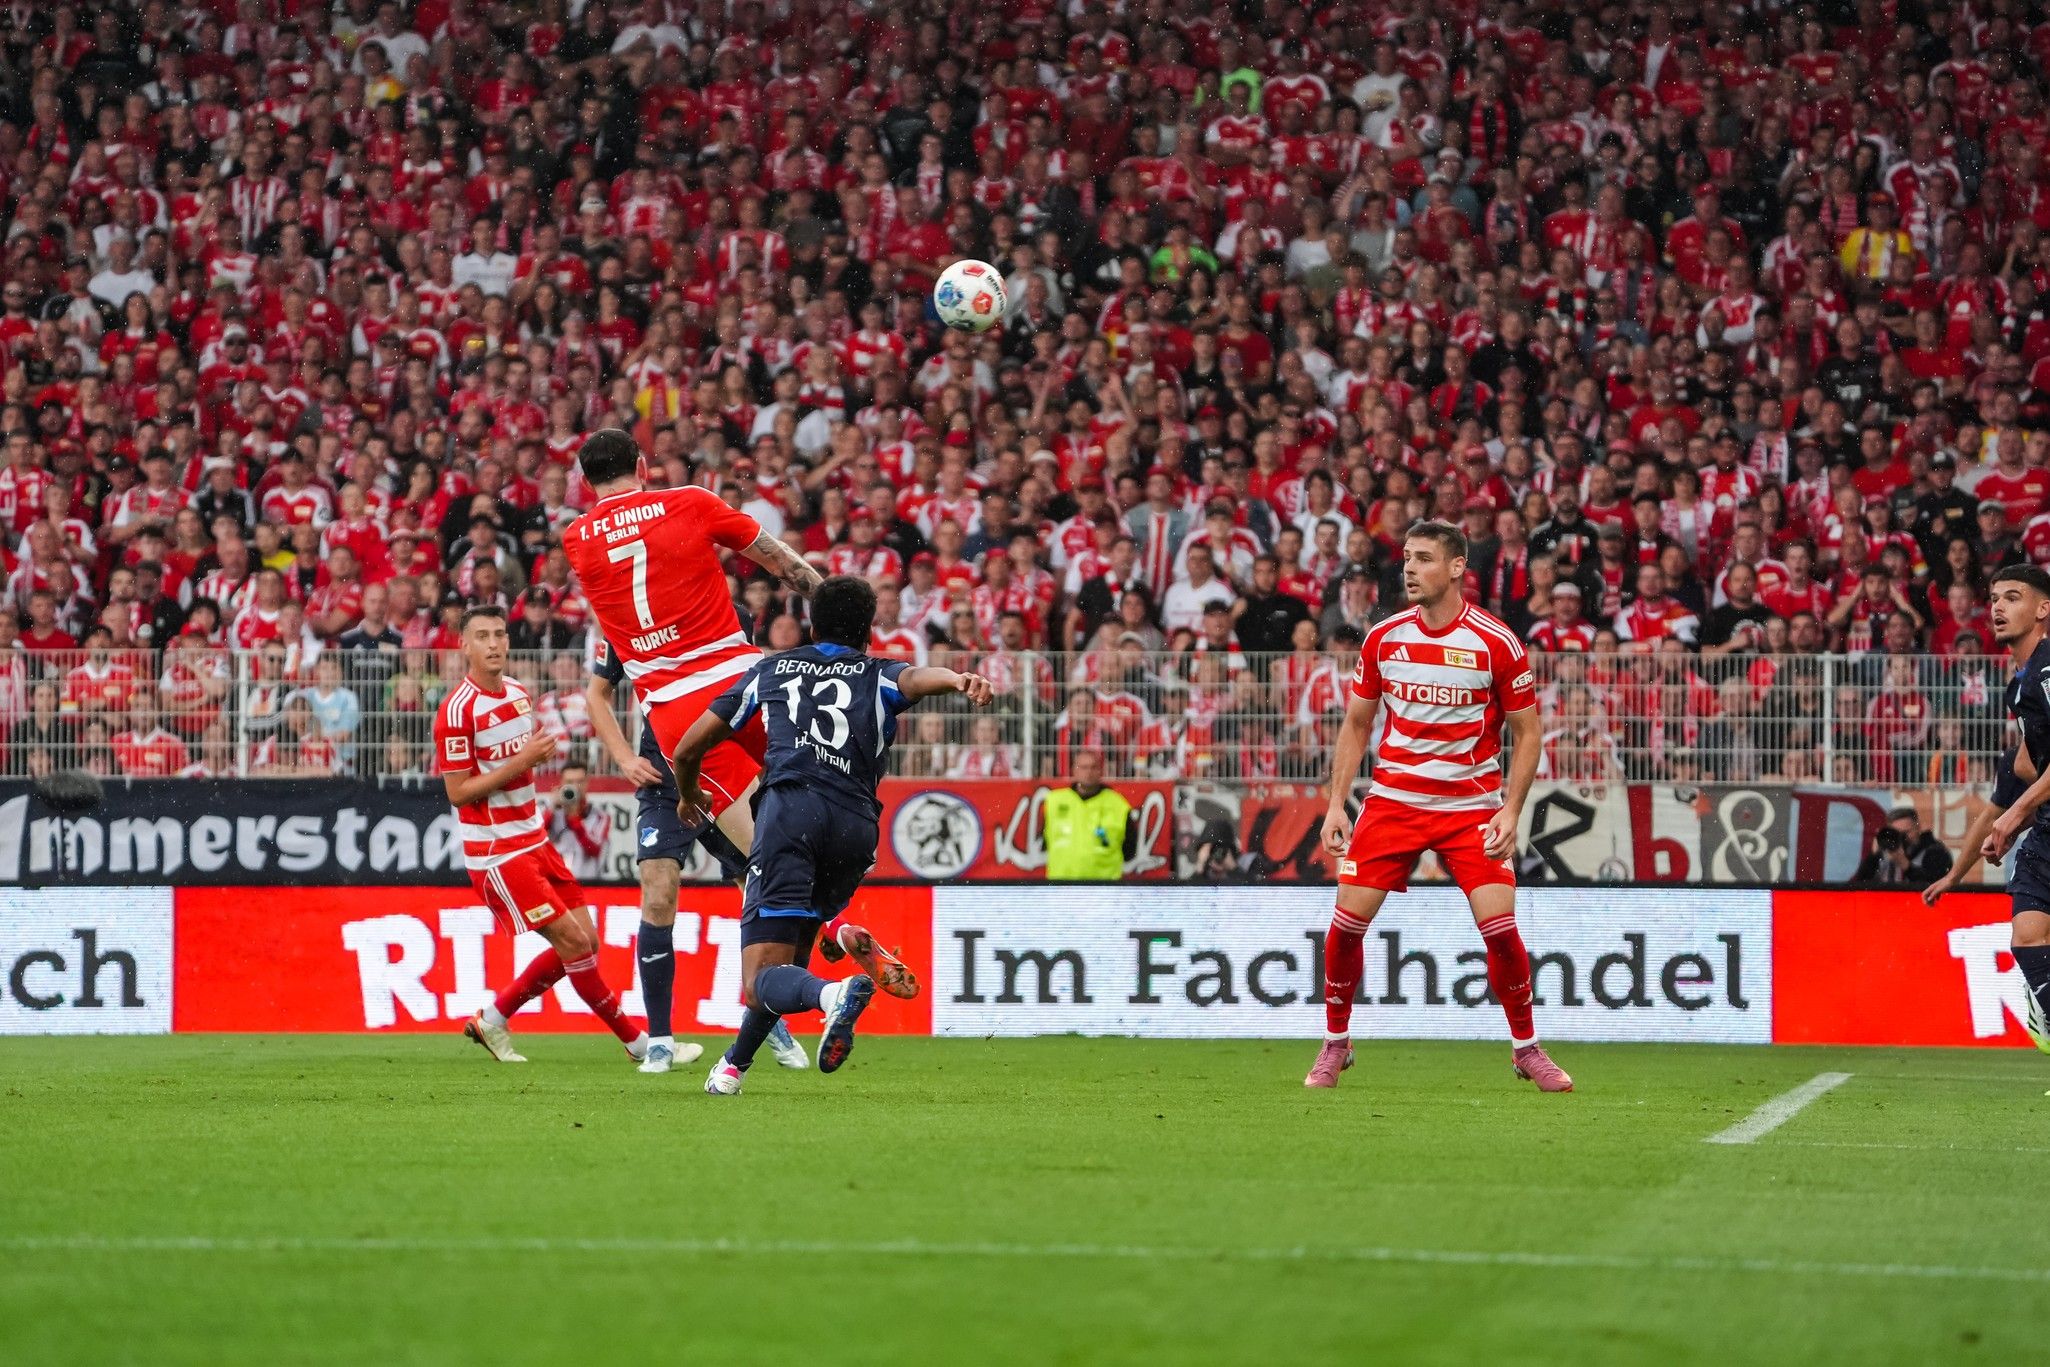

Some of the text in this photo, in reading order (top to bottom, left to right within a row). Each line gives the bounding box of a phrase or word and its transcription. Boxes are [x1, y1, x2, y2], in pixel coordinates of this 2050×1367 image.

[580, 525, 590, 541] 1.
[592, 517, 611, 536] FC
[613, 502, 666, 527] UNION
[606, 525, 640, 544] BERLIN
[607, 539, 655, 630] 7
[630, 624, 680, 653] BURKE
[775, 659, 865, 676] BERNARDO
[779, 674, 852, 750] 13
[1407, 681, 1472, 705] raisin
[0, 928, 145, 1010] ch
[953, 930, 1093, 1003] Im
